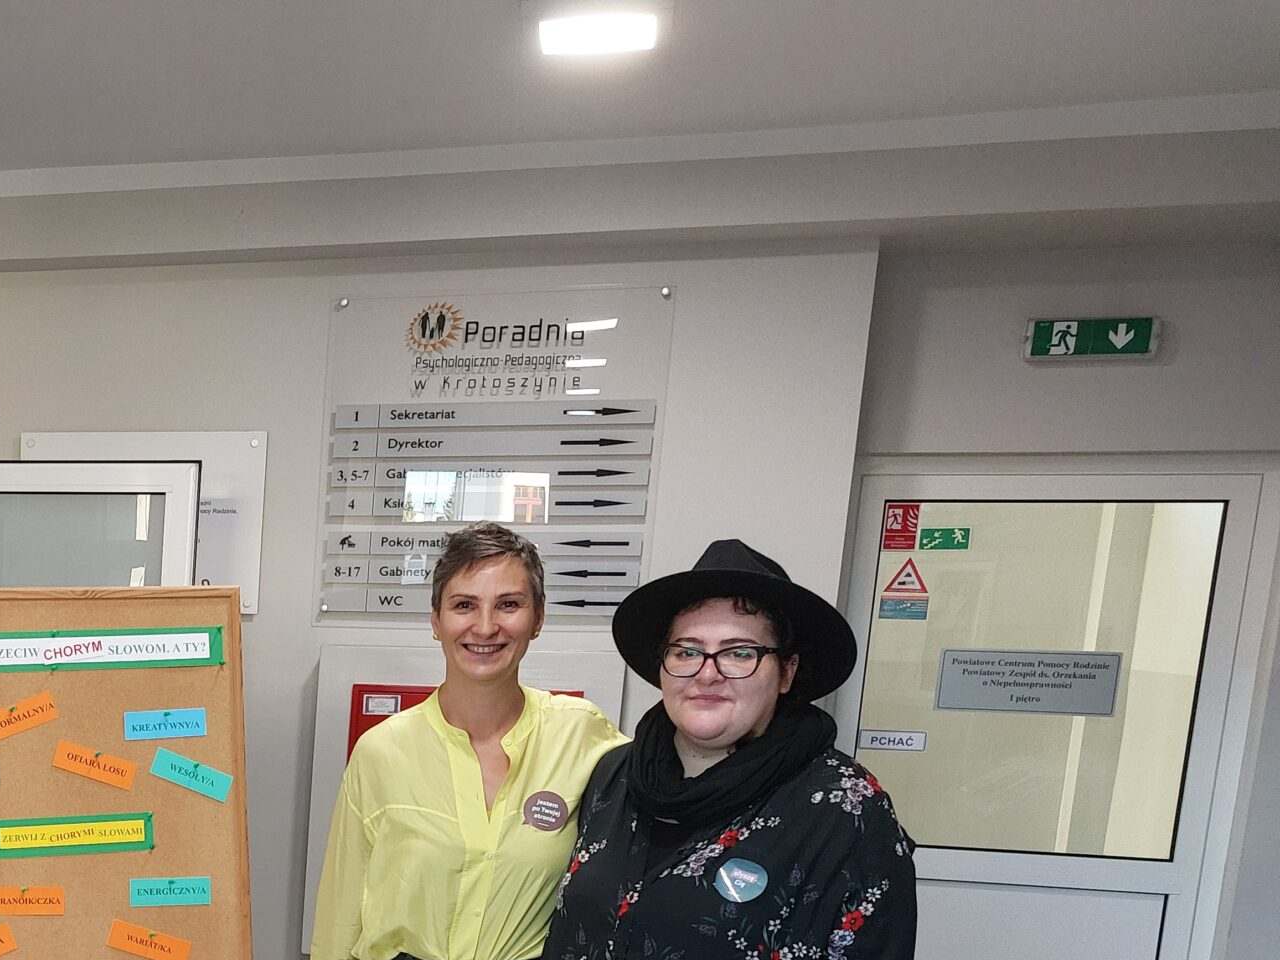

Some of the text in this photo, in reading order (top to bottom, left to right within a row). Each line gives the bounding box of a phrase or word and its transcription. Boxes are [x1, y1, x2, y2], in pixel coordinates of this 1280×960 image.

[464, 318, 585, 343] Poradnia
[442, 374, 581, 392] Krotoszynie
[354, 411, 360, 422] 1
[390, 409, 456, 421] Sekretariat
[352, 441, 359, 451] 2
[388, 438, 444, 452] Dyrektor
[350, 470, 369, 482] 5-7
[348, 499, 355, 510] 4
[381, 537, 414, 550] Pokój
[334, 566, 361, 577] 8-17
[379, 566, 432, 580] Gabinety
[379, 595, 404, 606] WC
[43, 640, 103, 660] CHORYM
[173, 643, 181, 653] A
[183, 642, 206, 652] TY?
[951, 658, 1111, 670] Powiatowe Centrum Pomocy Rodzinie
[962, 668, 1006, 678] Powiatowy
[1008, 669, 1036, 679] Zespół
[1052, 671, 1097, 680] Orzekania
[990, 679, 1072, 689] Niepełnosprawności
[1015, 694, 1041, 703] piętro
[131, 720, 200, 734] KREATYWNY/A
[870, 735, 914, 747] PCHAĆ
[67, 752, 128, 779] OFIARA LOSU
[2, 833, 38, 843] ZERWIJ
[40, 832, 46, 841] Z
[49, 828, 95, 843] CHORYMI
[136, 886, 207, 897] ENERGICZNY/A
[126, 934, 172, 954] WARIAT/KA
